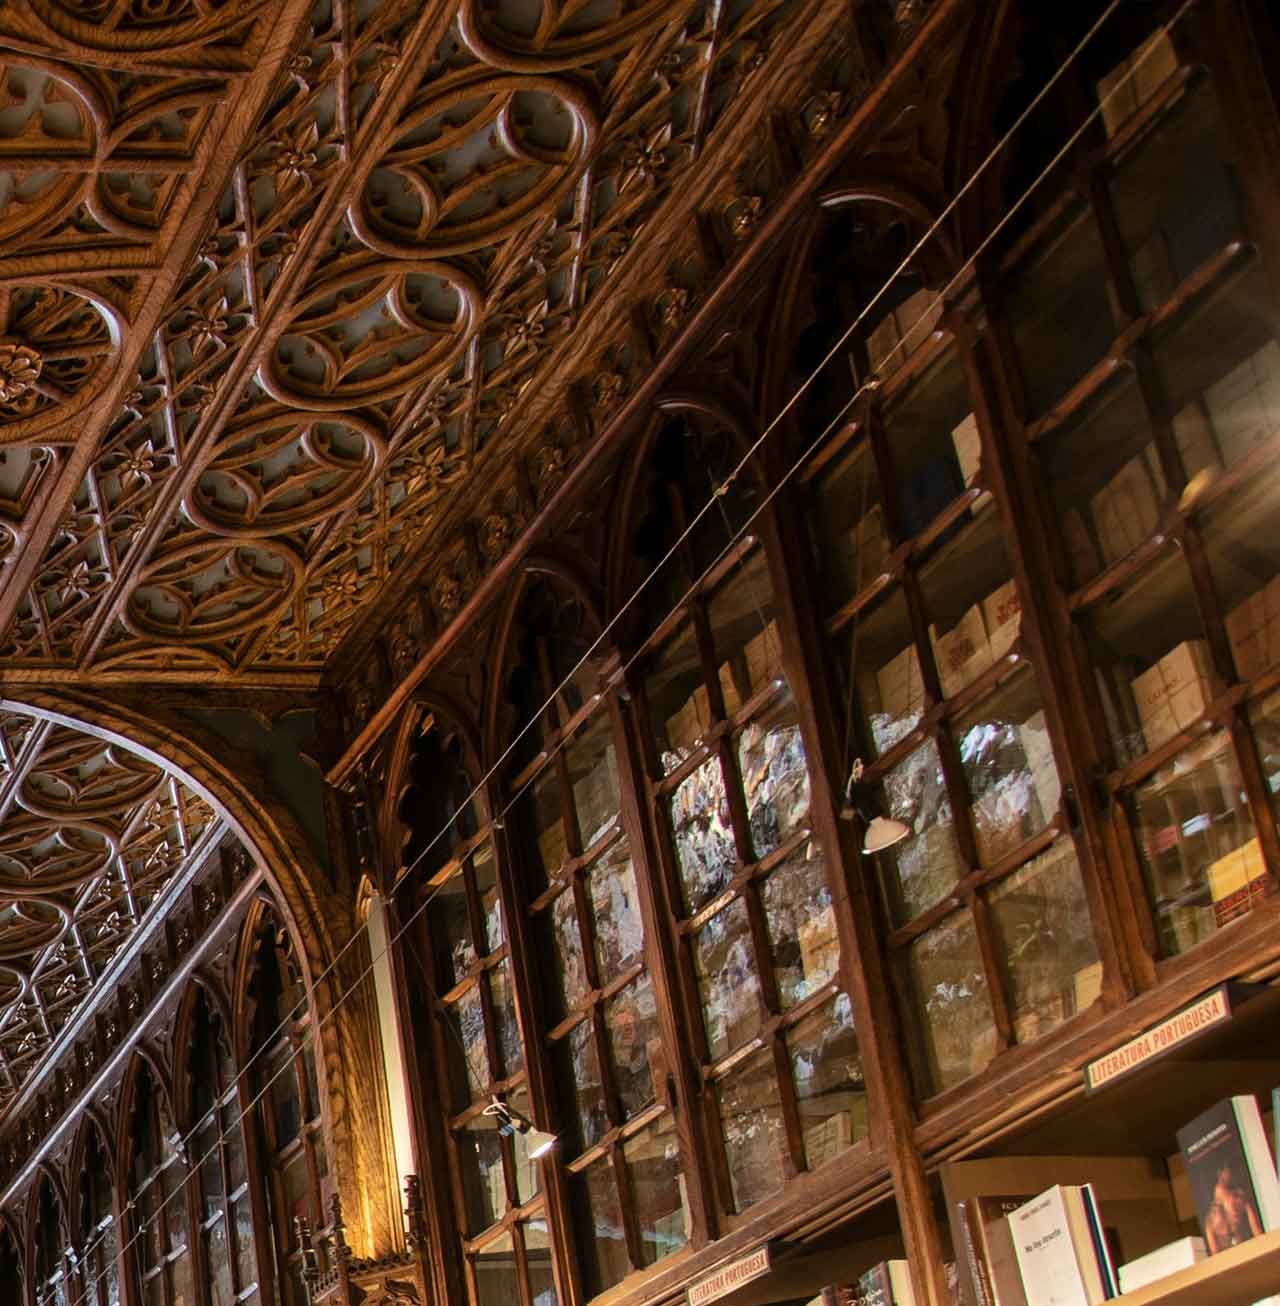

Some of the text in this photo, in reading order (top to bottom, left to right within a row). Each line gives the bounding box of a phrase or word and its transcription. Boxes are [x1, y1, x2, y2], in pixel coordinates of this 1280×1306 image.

[1091, 999, 1220, 1083] LITERATURA PORTUGUESA
[690, 1254, 766, 1304] LITERATURA PORTUGUESA
